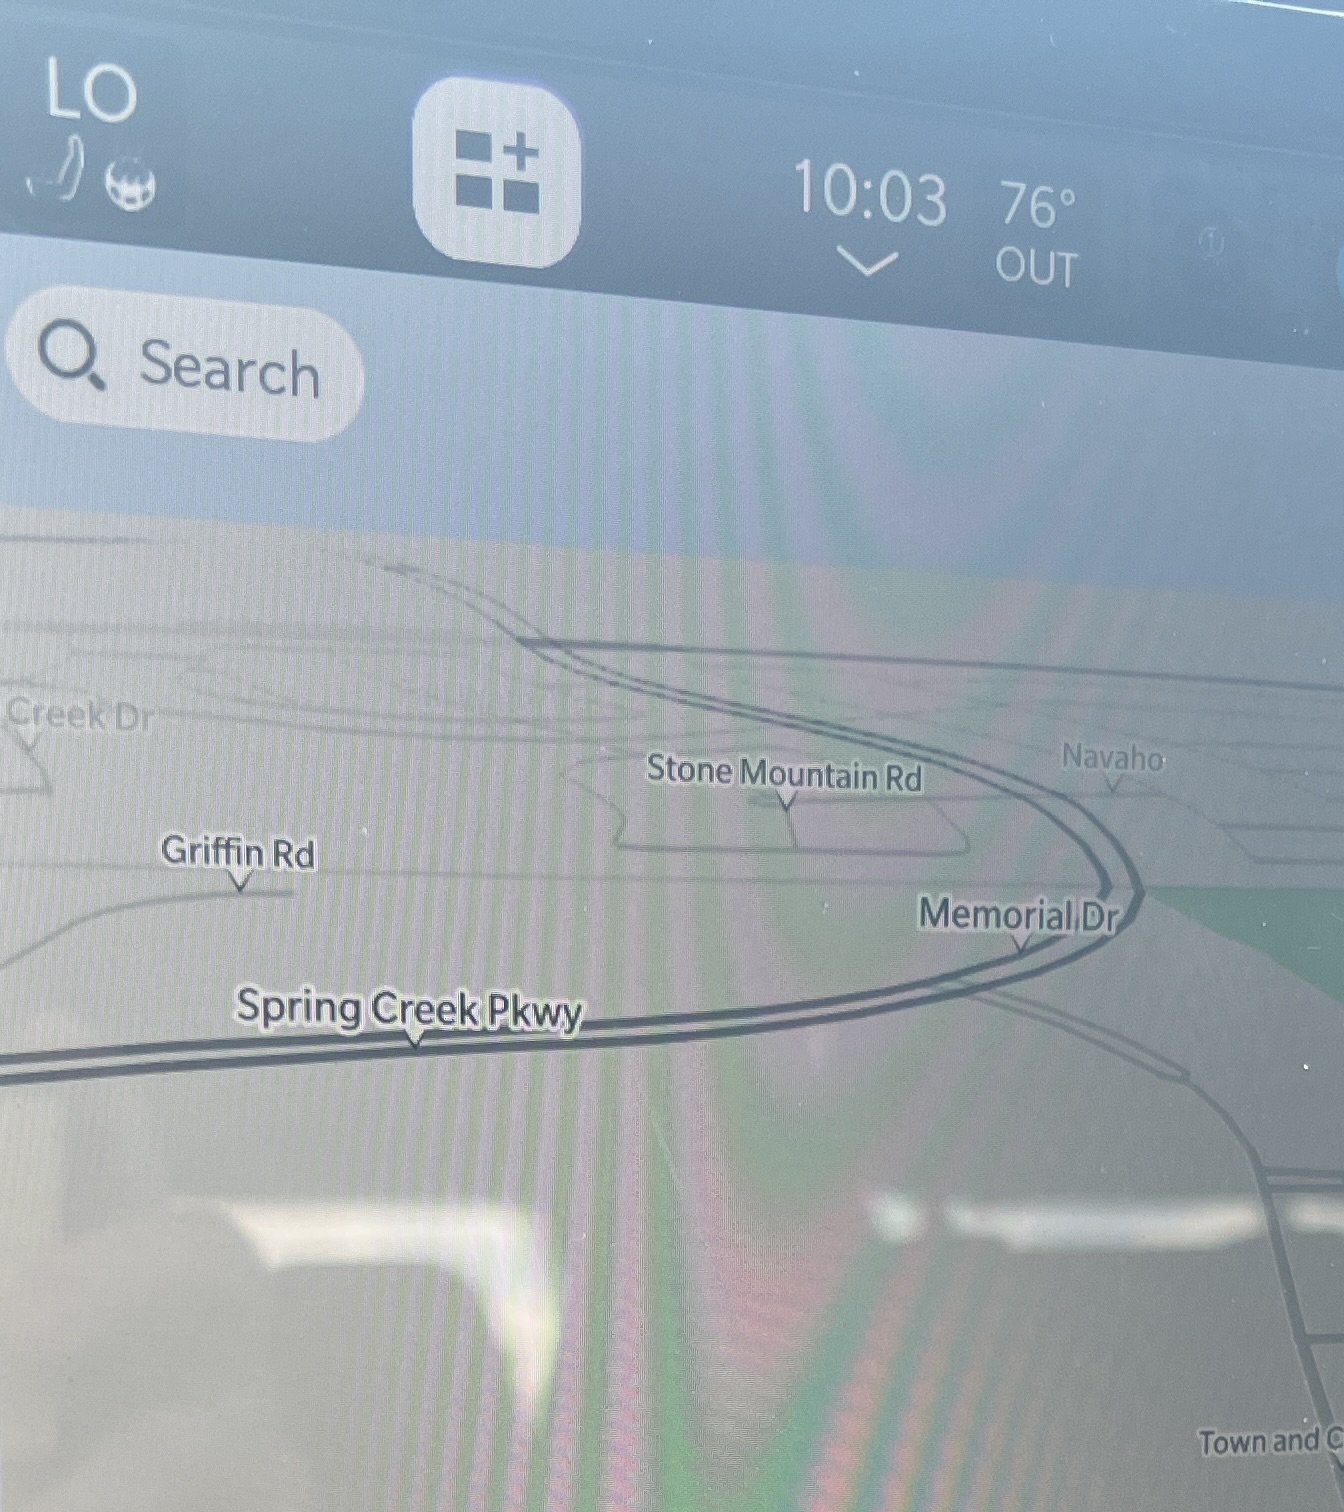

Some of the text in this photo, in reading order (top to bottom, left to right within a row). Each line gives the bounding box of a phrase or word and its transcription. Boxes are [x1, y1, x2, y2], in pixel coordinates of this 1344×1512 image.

[47, 56, 138, 123] LO
[794, 157, 948, 228] 10:03
[1000, 179, 1077, 230] 76°
[995, 244, 1080, 290] OUT
[140, 337, 321, 399] Search
[7, 695, 106, 729] Creek
[115, 701, 155, 732] Dr
[646, 753, 923, 793] Stone Mountain Rd
[1062, 741, 1165, 772] Navaho
[160, 832, 316, 870] Griffin Rd
[918, 896, 1119, 932] Memorial Dr
[236, 986, 584, 1035] Spring Creek Pkwy
[1199, 1430, 1266, 1455] Town
[1273, 1427, 1320, 1451] and
